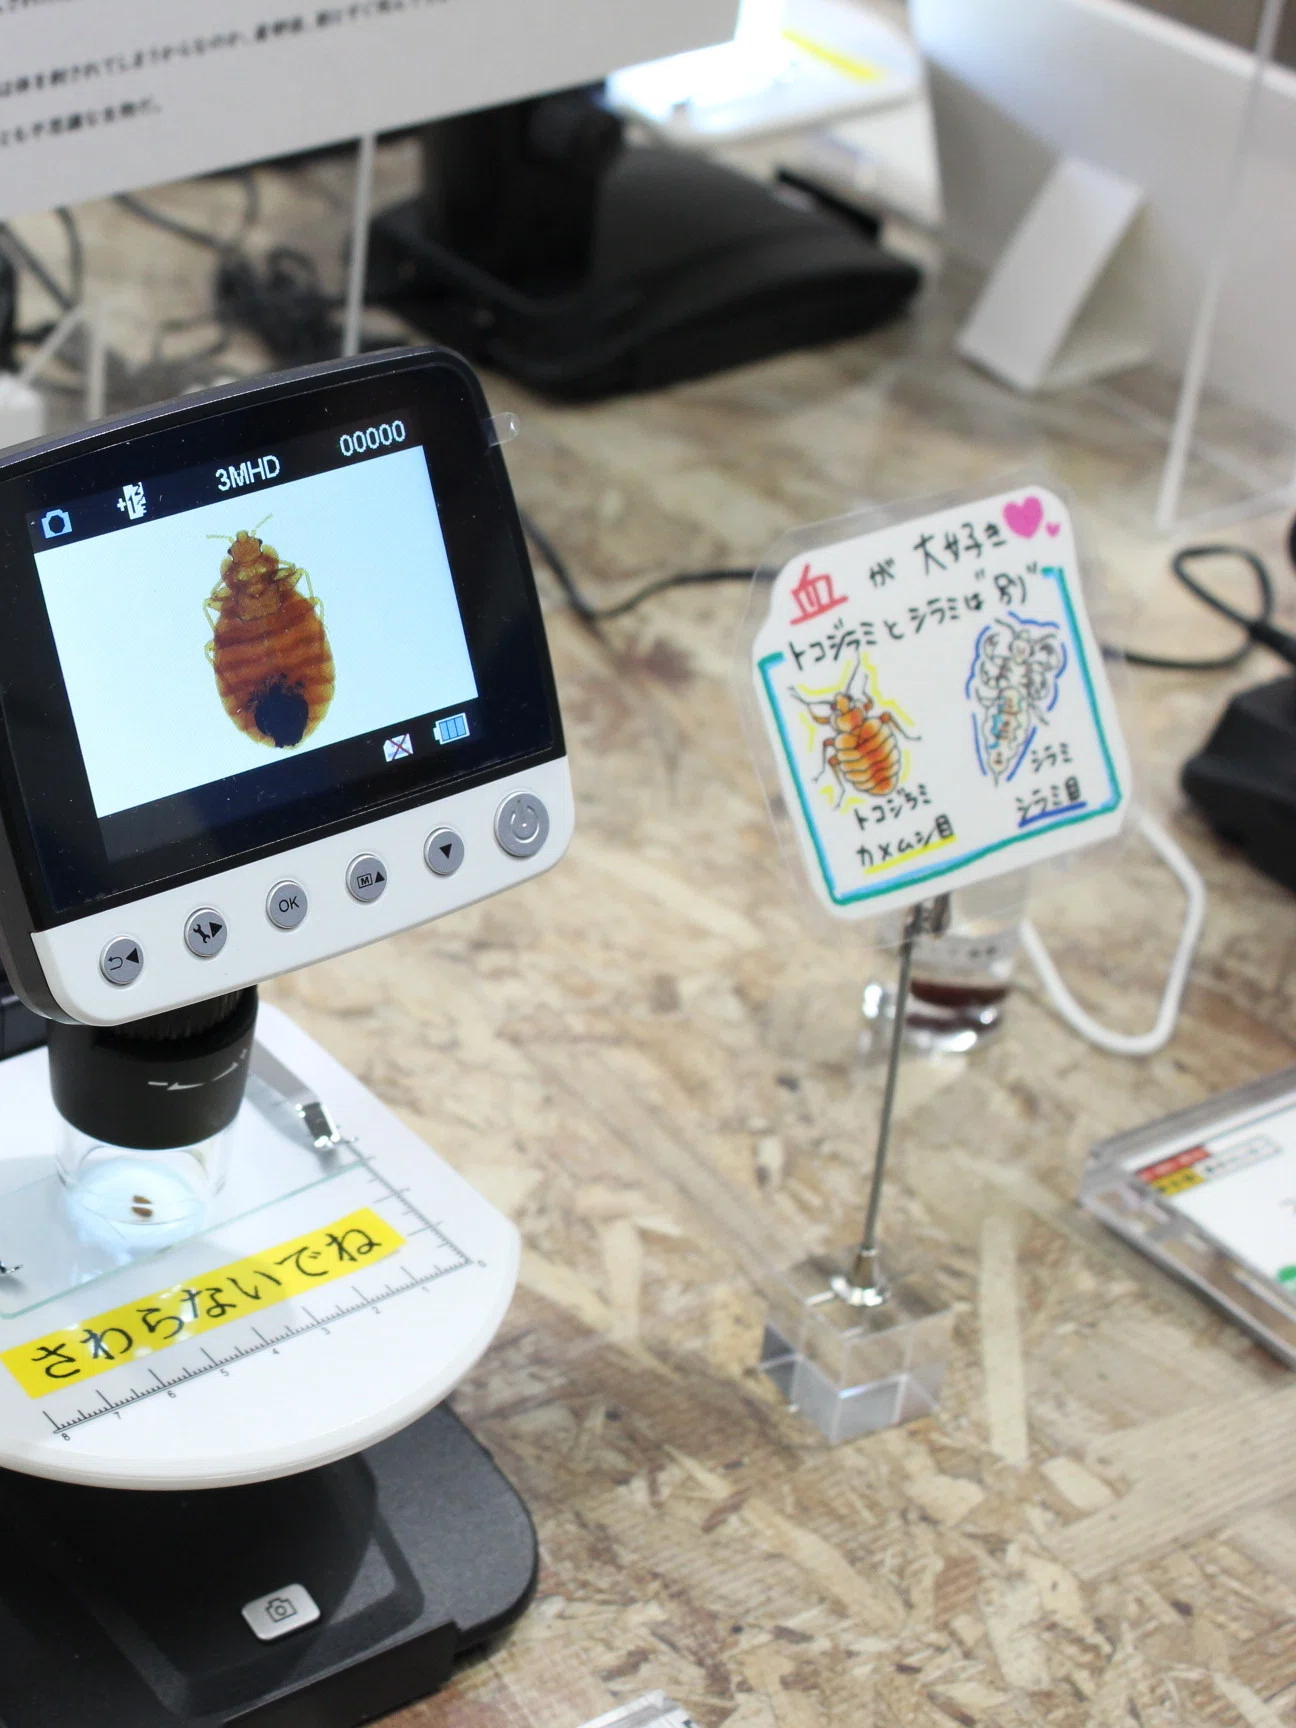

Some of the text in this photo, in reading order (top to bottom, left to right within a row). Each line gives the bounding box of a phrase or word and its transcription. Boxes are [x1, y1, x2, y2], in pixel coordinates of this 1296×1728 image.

[339, 420, 406, 456] 00000
[215, 455, 281, 492] 3MHD
[1031, 742, 1074, 773] シラミ
[278, 896, 300, 913] OK
[30, 1227, 383, 1380] さわらないでね
[61, 1432, 71, 1442] 8
[113, 1411, 122, 1421] 7
[167, 1390, 177, 1399] 6
[220, 1368, 230, 1377] 5
[271, 1347, 281, 1356] 4
[321, 1327, 331, 1336] 3
[372, 1305, 382, 1315] 2
